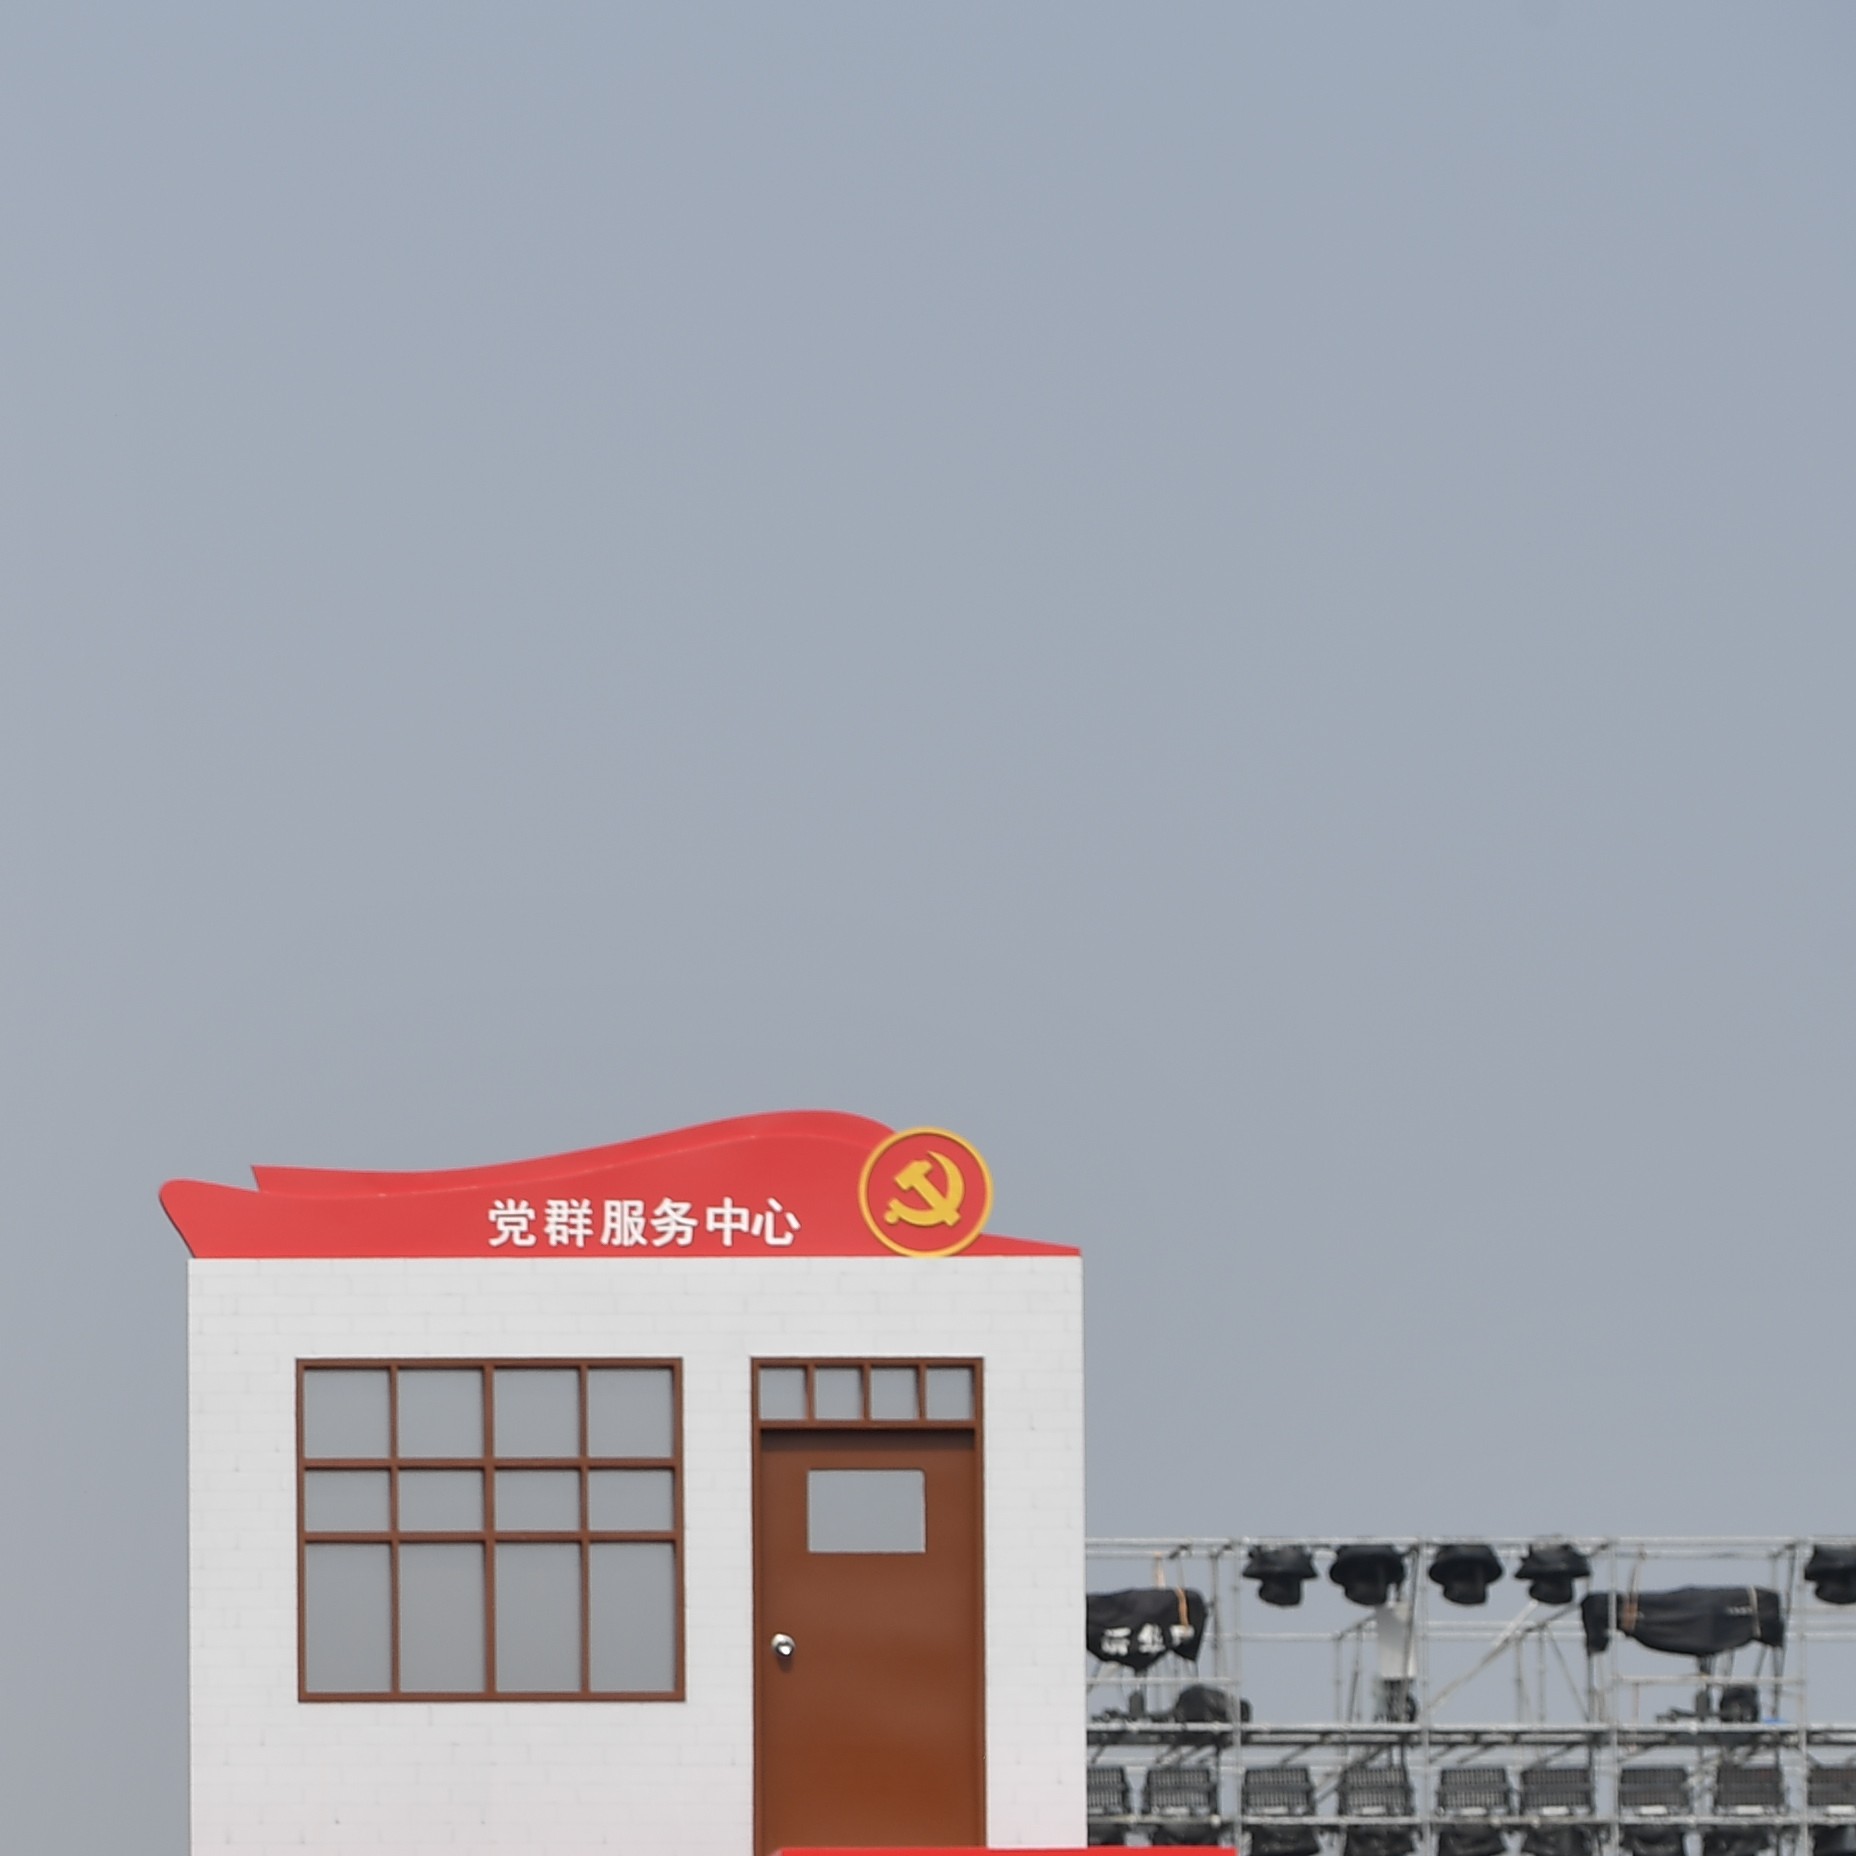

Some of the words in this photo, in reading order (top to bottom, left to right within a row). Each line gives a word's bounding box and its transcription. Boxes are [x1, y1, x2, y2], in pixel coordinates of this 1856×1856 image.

[487, 1197, 802, 1248] 党群服务中心
